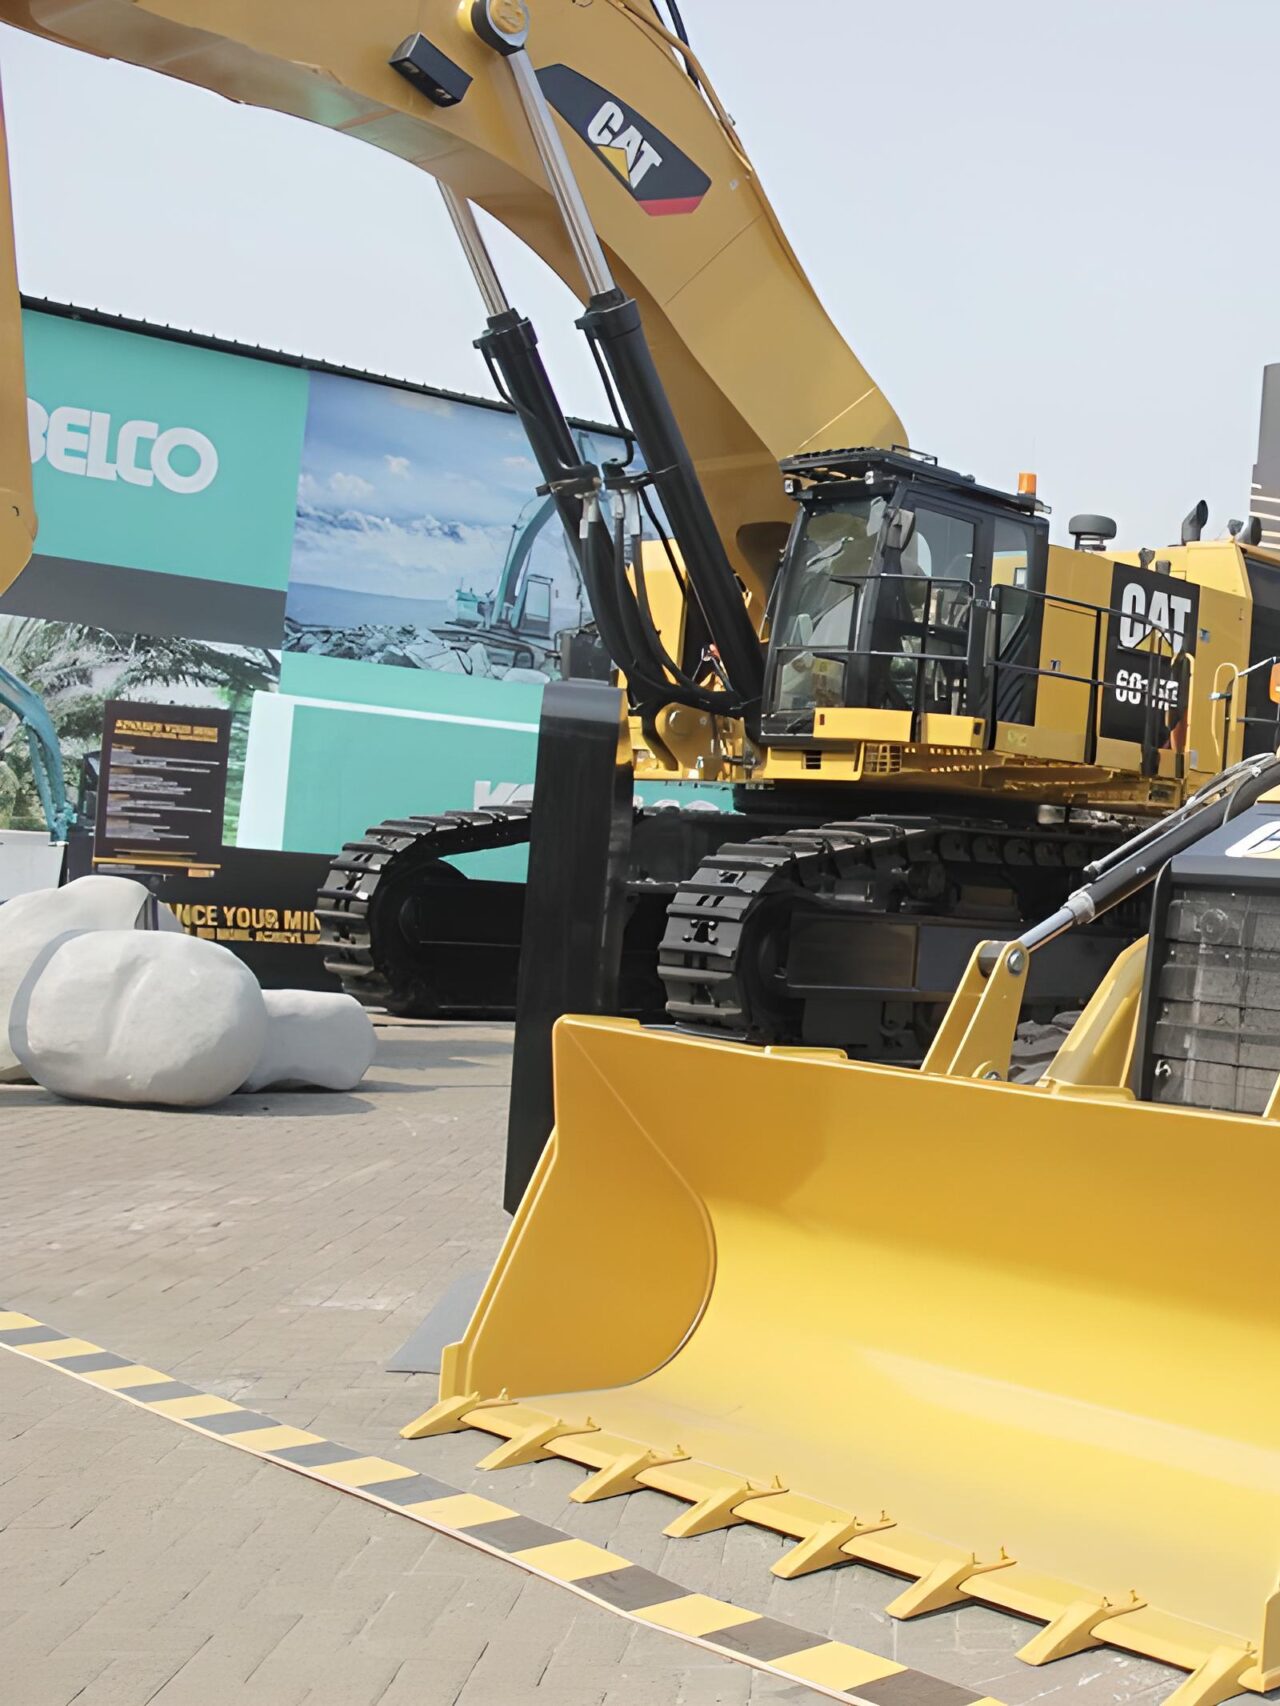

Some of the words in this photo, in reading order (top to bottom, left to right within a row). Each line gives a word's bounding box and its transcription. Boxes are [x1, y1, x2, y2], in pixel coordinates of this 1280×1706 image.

[587, 101, 663, 189] CAT
[1119, 582, 1192, 656] CAT
[223, 906, 279, 930] YOUR
